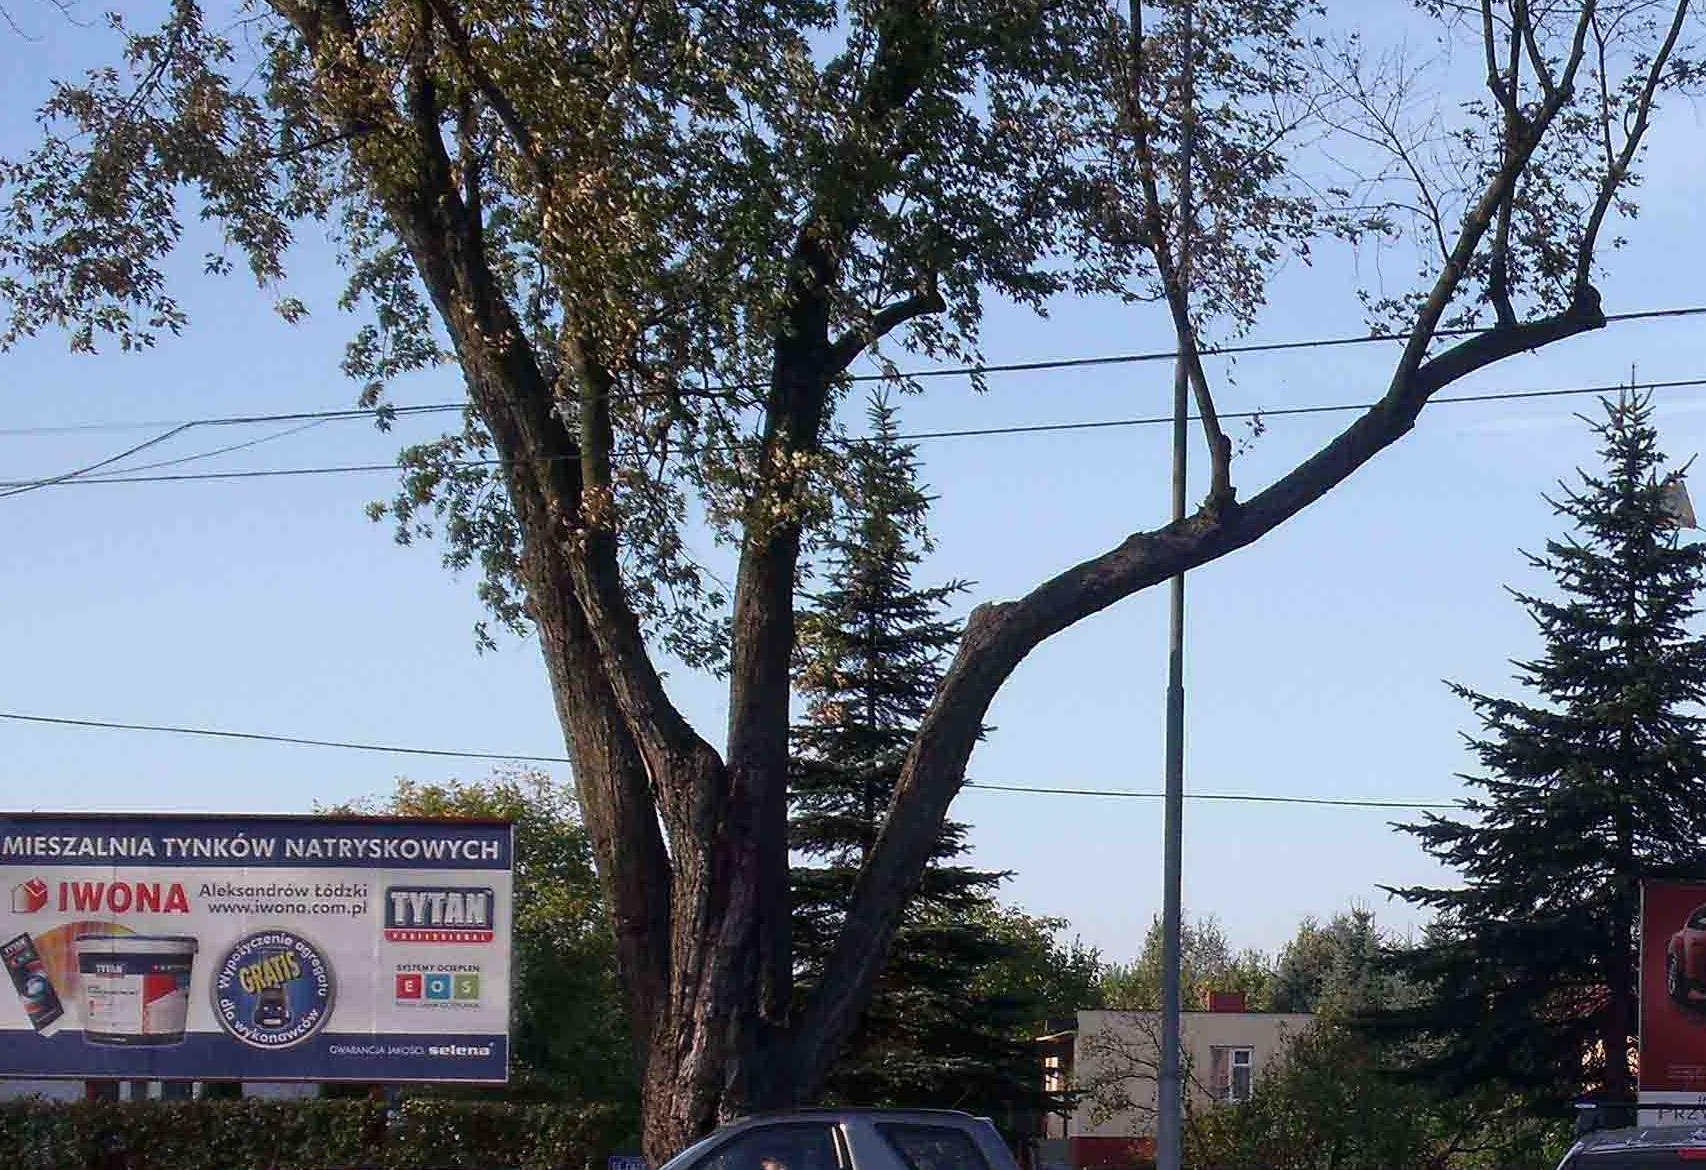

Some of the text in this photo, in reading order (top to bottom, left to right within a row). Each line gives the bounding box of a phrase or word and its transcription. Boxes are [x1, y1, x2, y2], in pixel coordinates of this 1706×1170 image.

[2, 832, 499, 860] MIESZALNIA TYNKÓW NATRYSKOWYCH
[57, 881, 190, 914] IWONA
[199, 883, 368, 898] Aleksandrów Łódzki
[208, 899, 368, 918] www.iwona.com.pl
[390, 890, 488, 927] TYTAN
[217, 932, 329, 997] Wypożyczenia agregatu
[240, 951, 302, 994] GRATIS
[428, 1043, 491, 1056] selena
